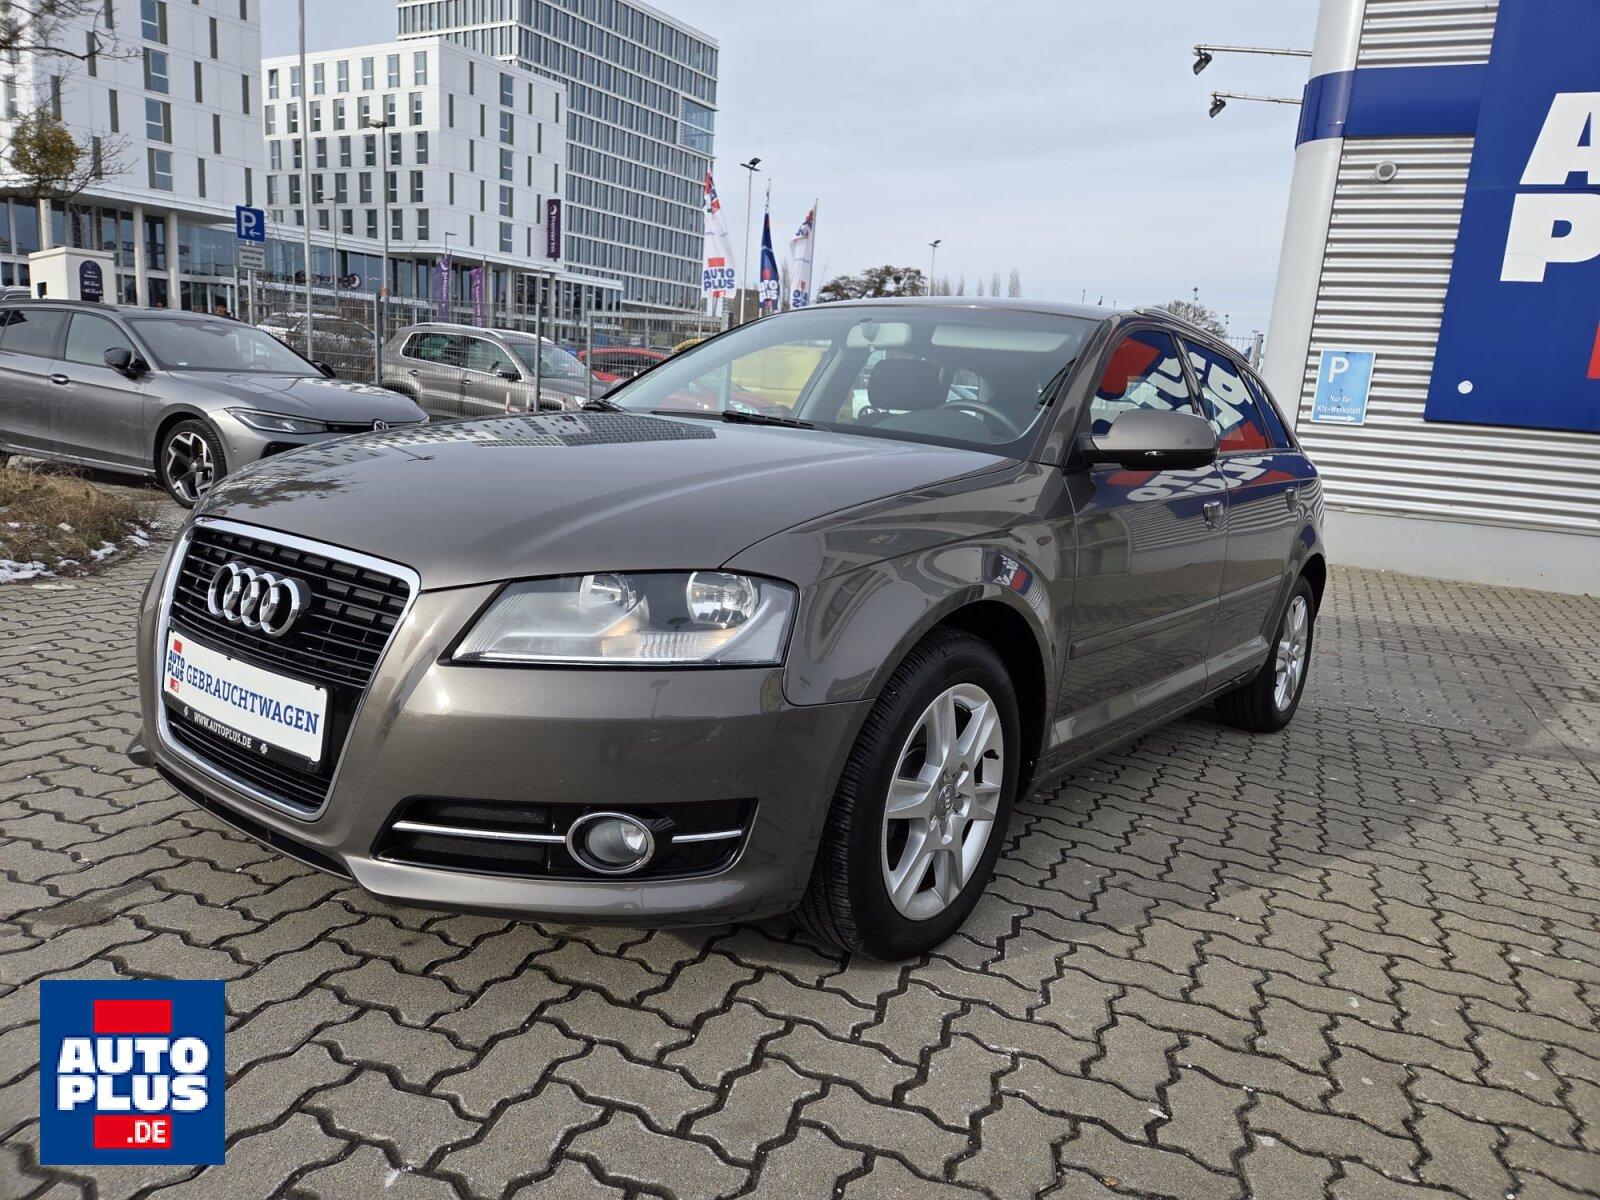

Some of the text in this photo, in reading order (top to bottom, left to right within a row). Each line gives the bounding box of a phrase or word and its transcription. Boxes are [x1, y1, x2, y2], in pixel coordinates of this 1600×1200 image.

[240, 210, 257, 236] P
[703, 268, 735, 280] AUTO
[703, 279, 735, 292] PLUS
[1328, 356, 1350, 383] P
[1330, 394, 1352, 403] Nur für
[1317, 405, 1361, 415] Kfz-Werkstatt
[168, 650, 185, 669] AUTO
[167, 662, 184, 682] PLUS
[186, 664, 320, 735] GEBRAUCHTWAGEN
[193, 711, 252, 750] WWW.AUTOPLUS.DE
